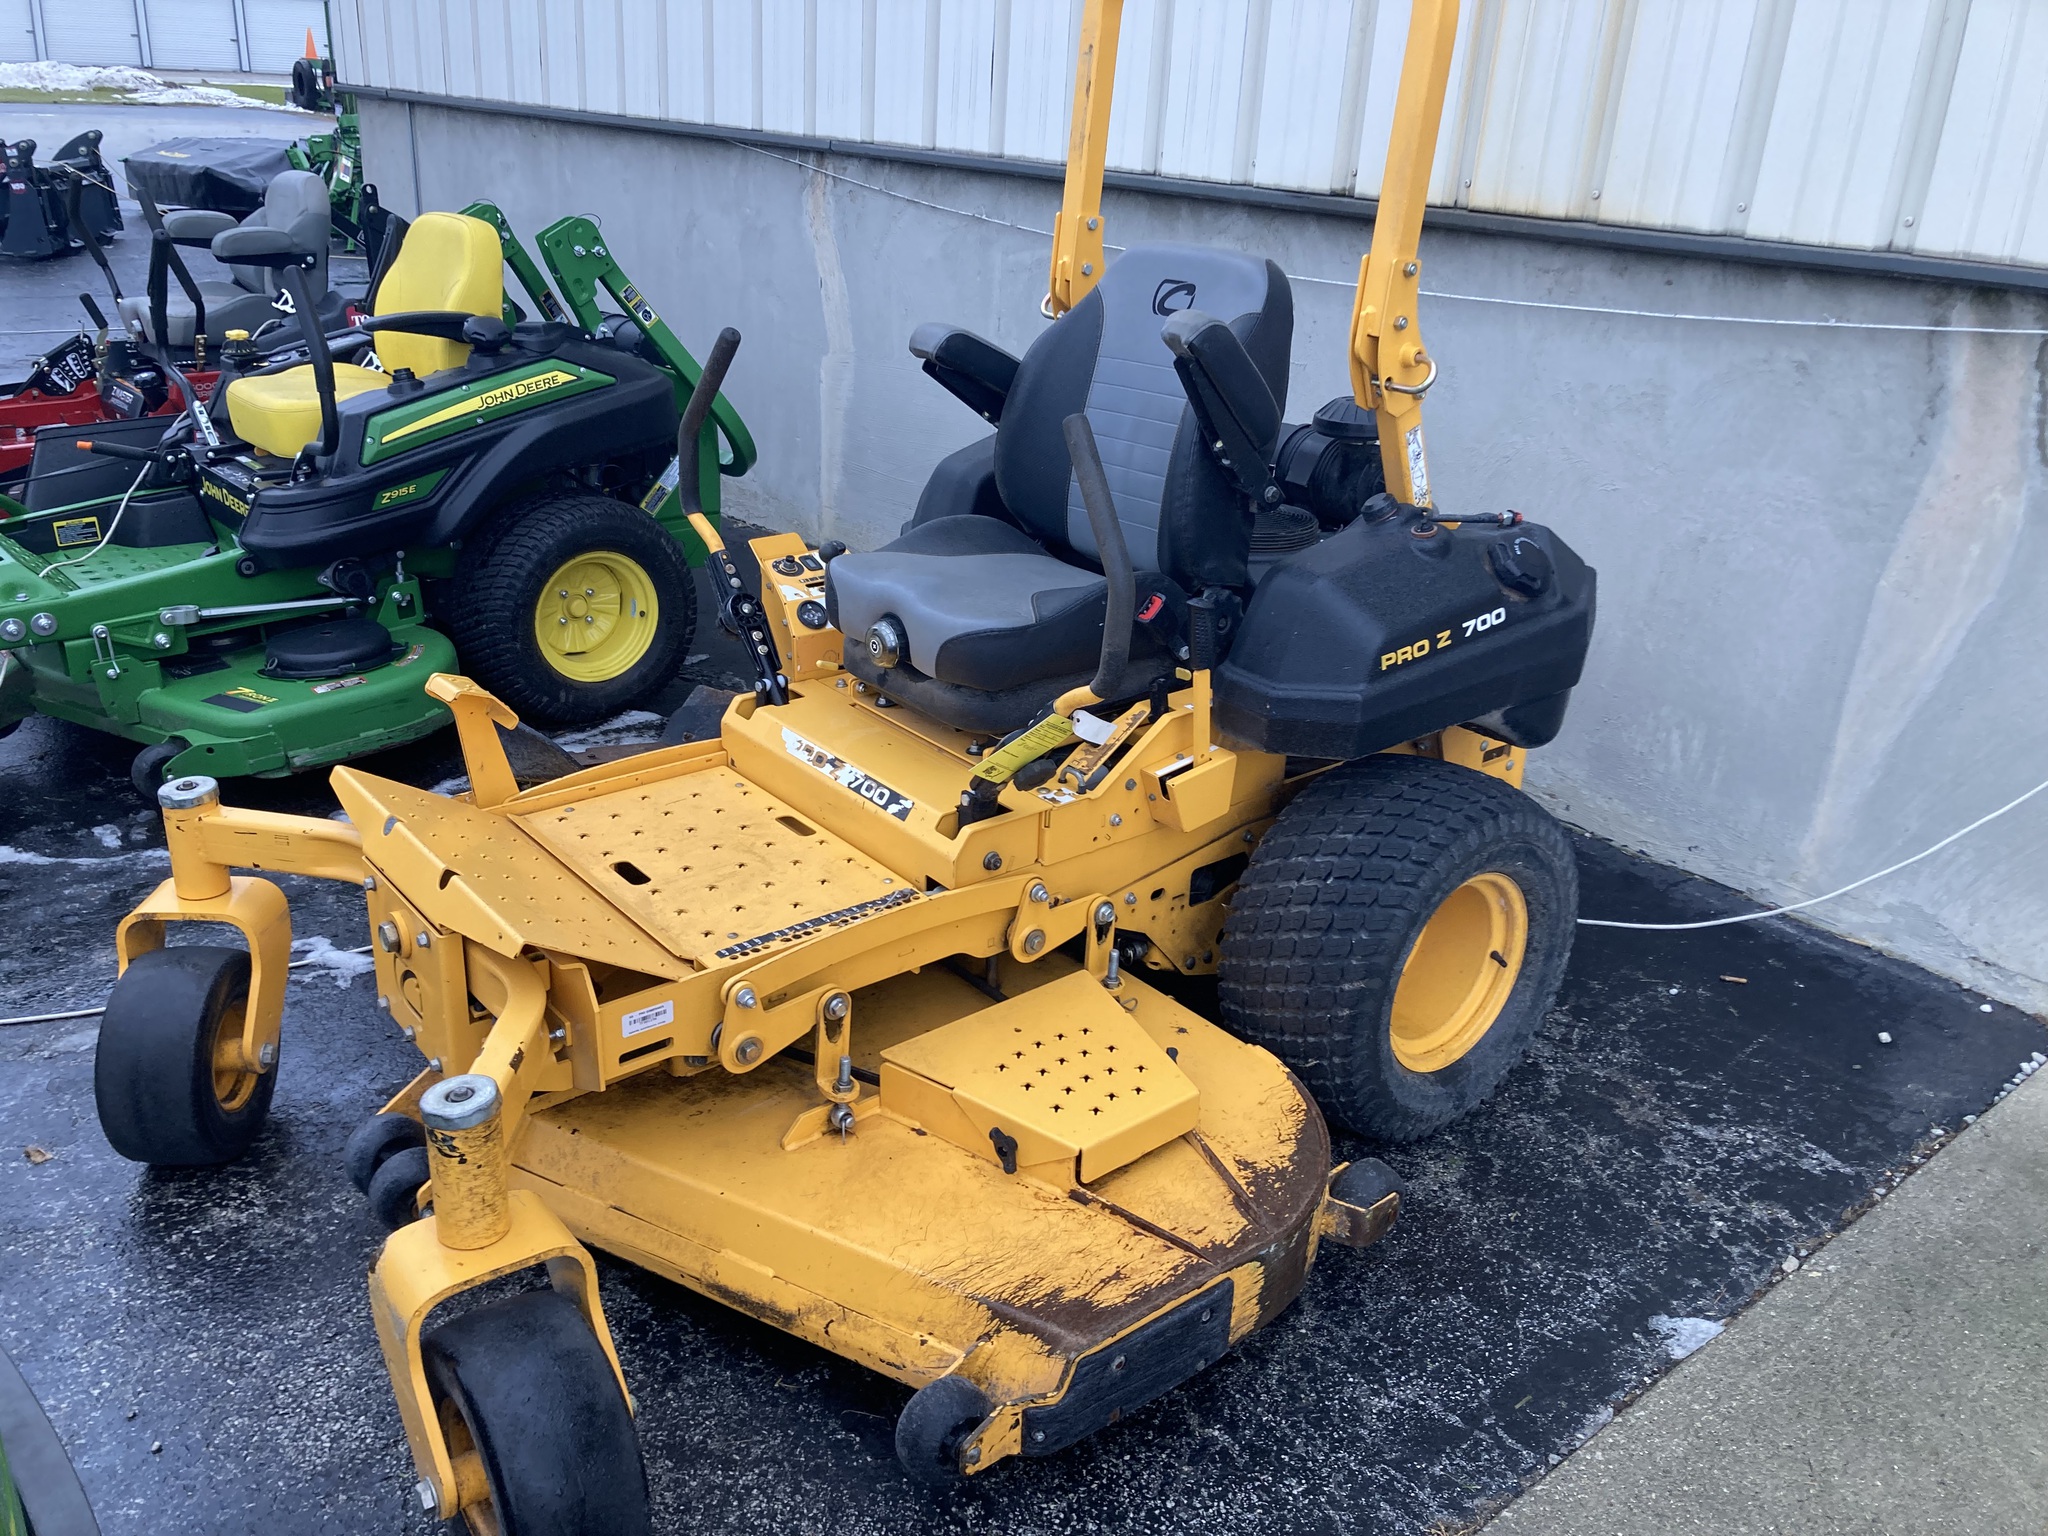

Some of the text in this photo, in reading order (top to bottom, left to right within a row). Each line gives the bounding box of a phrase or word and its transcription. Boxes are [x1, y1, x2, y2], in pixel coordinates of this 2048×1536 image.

[478, 374, 560, 409] JOHN DEERE
[202, 475, 224, 503] JOHN
[381, 484, 417, 504] Z915E
[1380, 607, 1506, 671] PRO Z 700
[848, 775, 891, 806] 700
